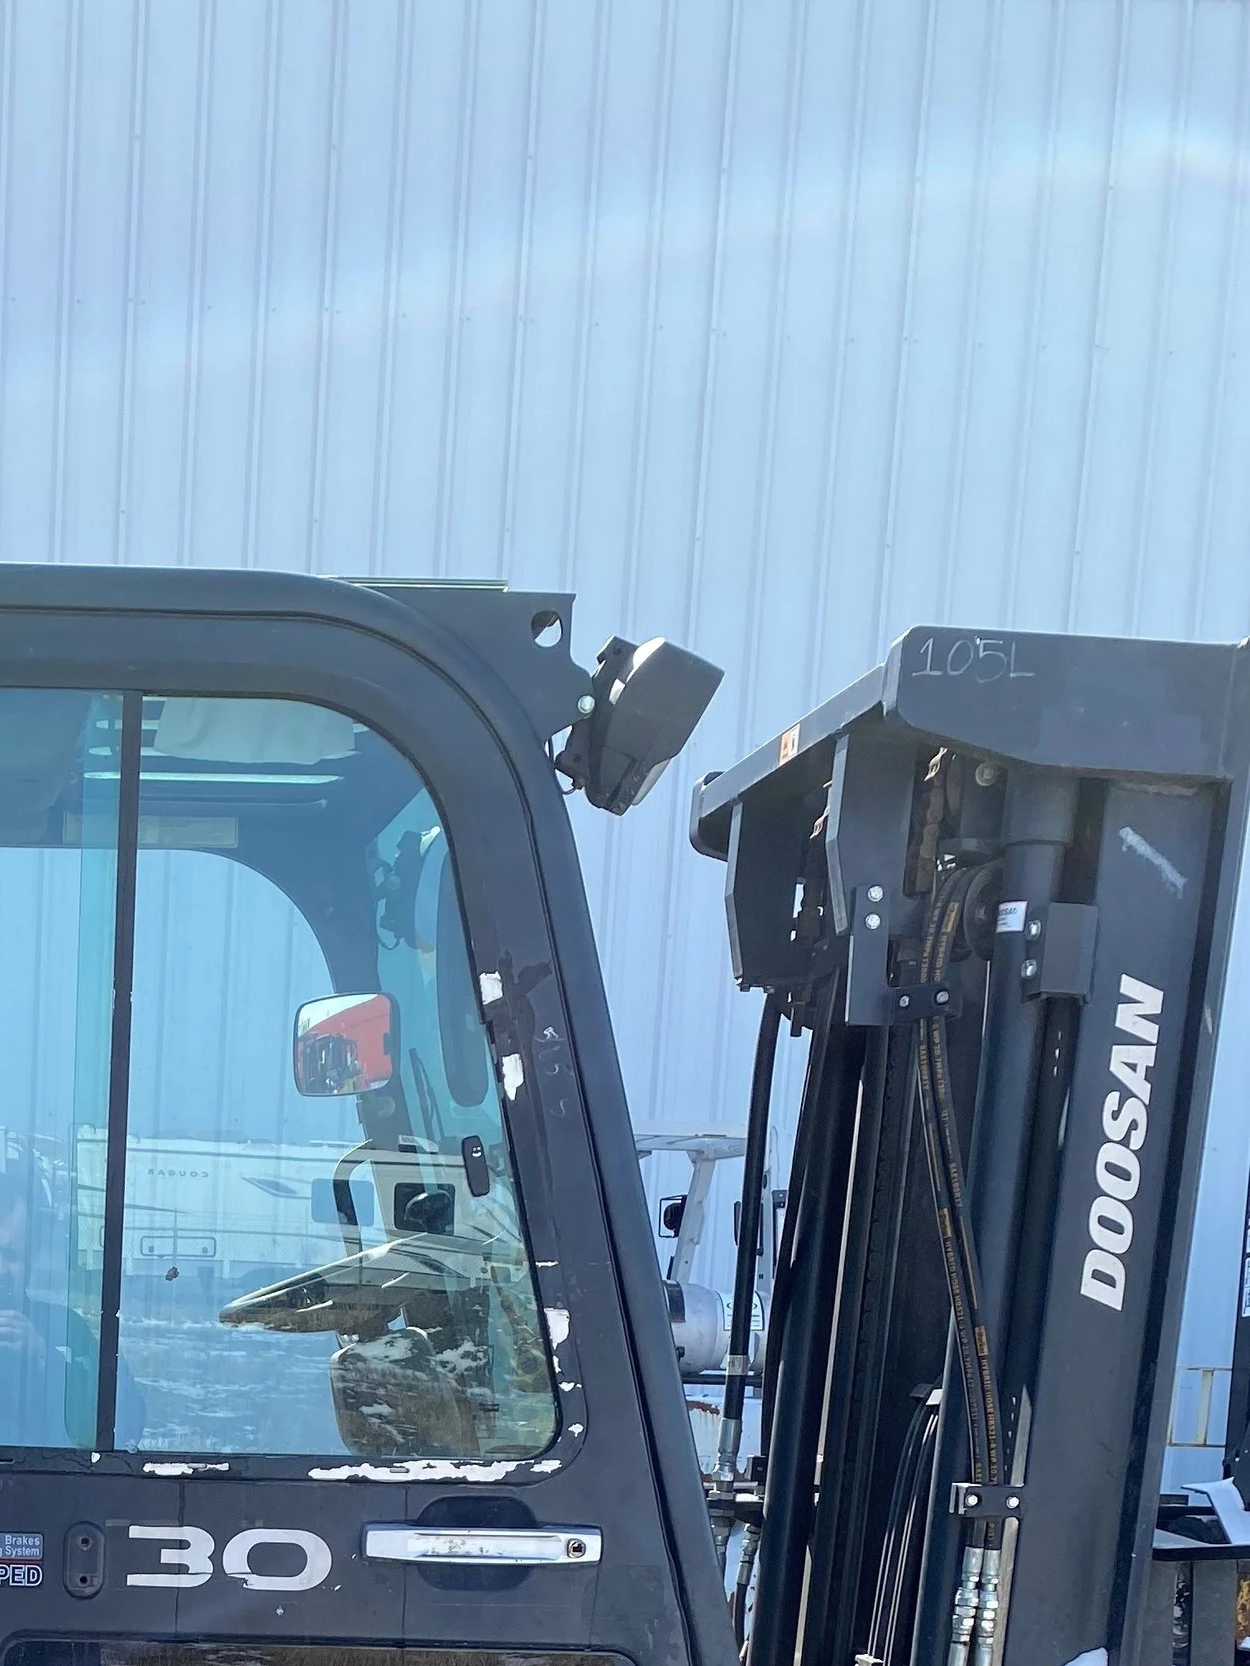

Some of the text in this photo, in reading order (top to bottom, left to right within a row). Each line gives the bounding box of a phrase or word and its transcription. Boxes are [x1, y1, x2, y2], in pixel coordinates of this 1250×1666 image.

[1080, 973, 1164, 1312] DOOSAN
[5, 1535, 40, 1546] Brakes
[5, 1545, 40, 1558] System
[126, 1525, 333, 1592] 30
